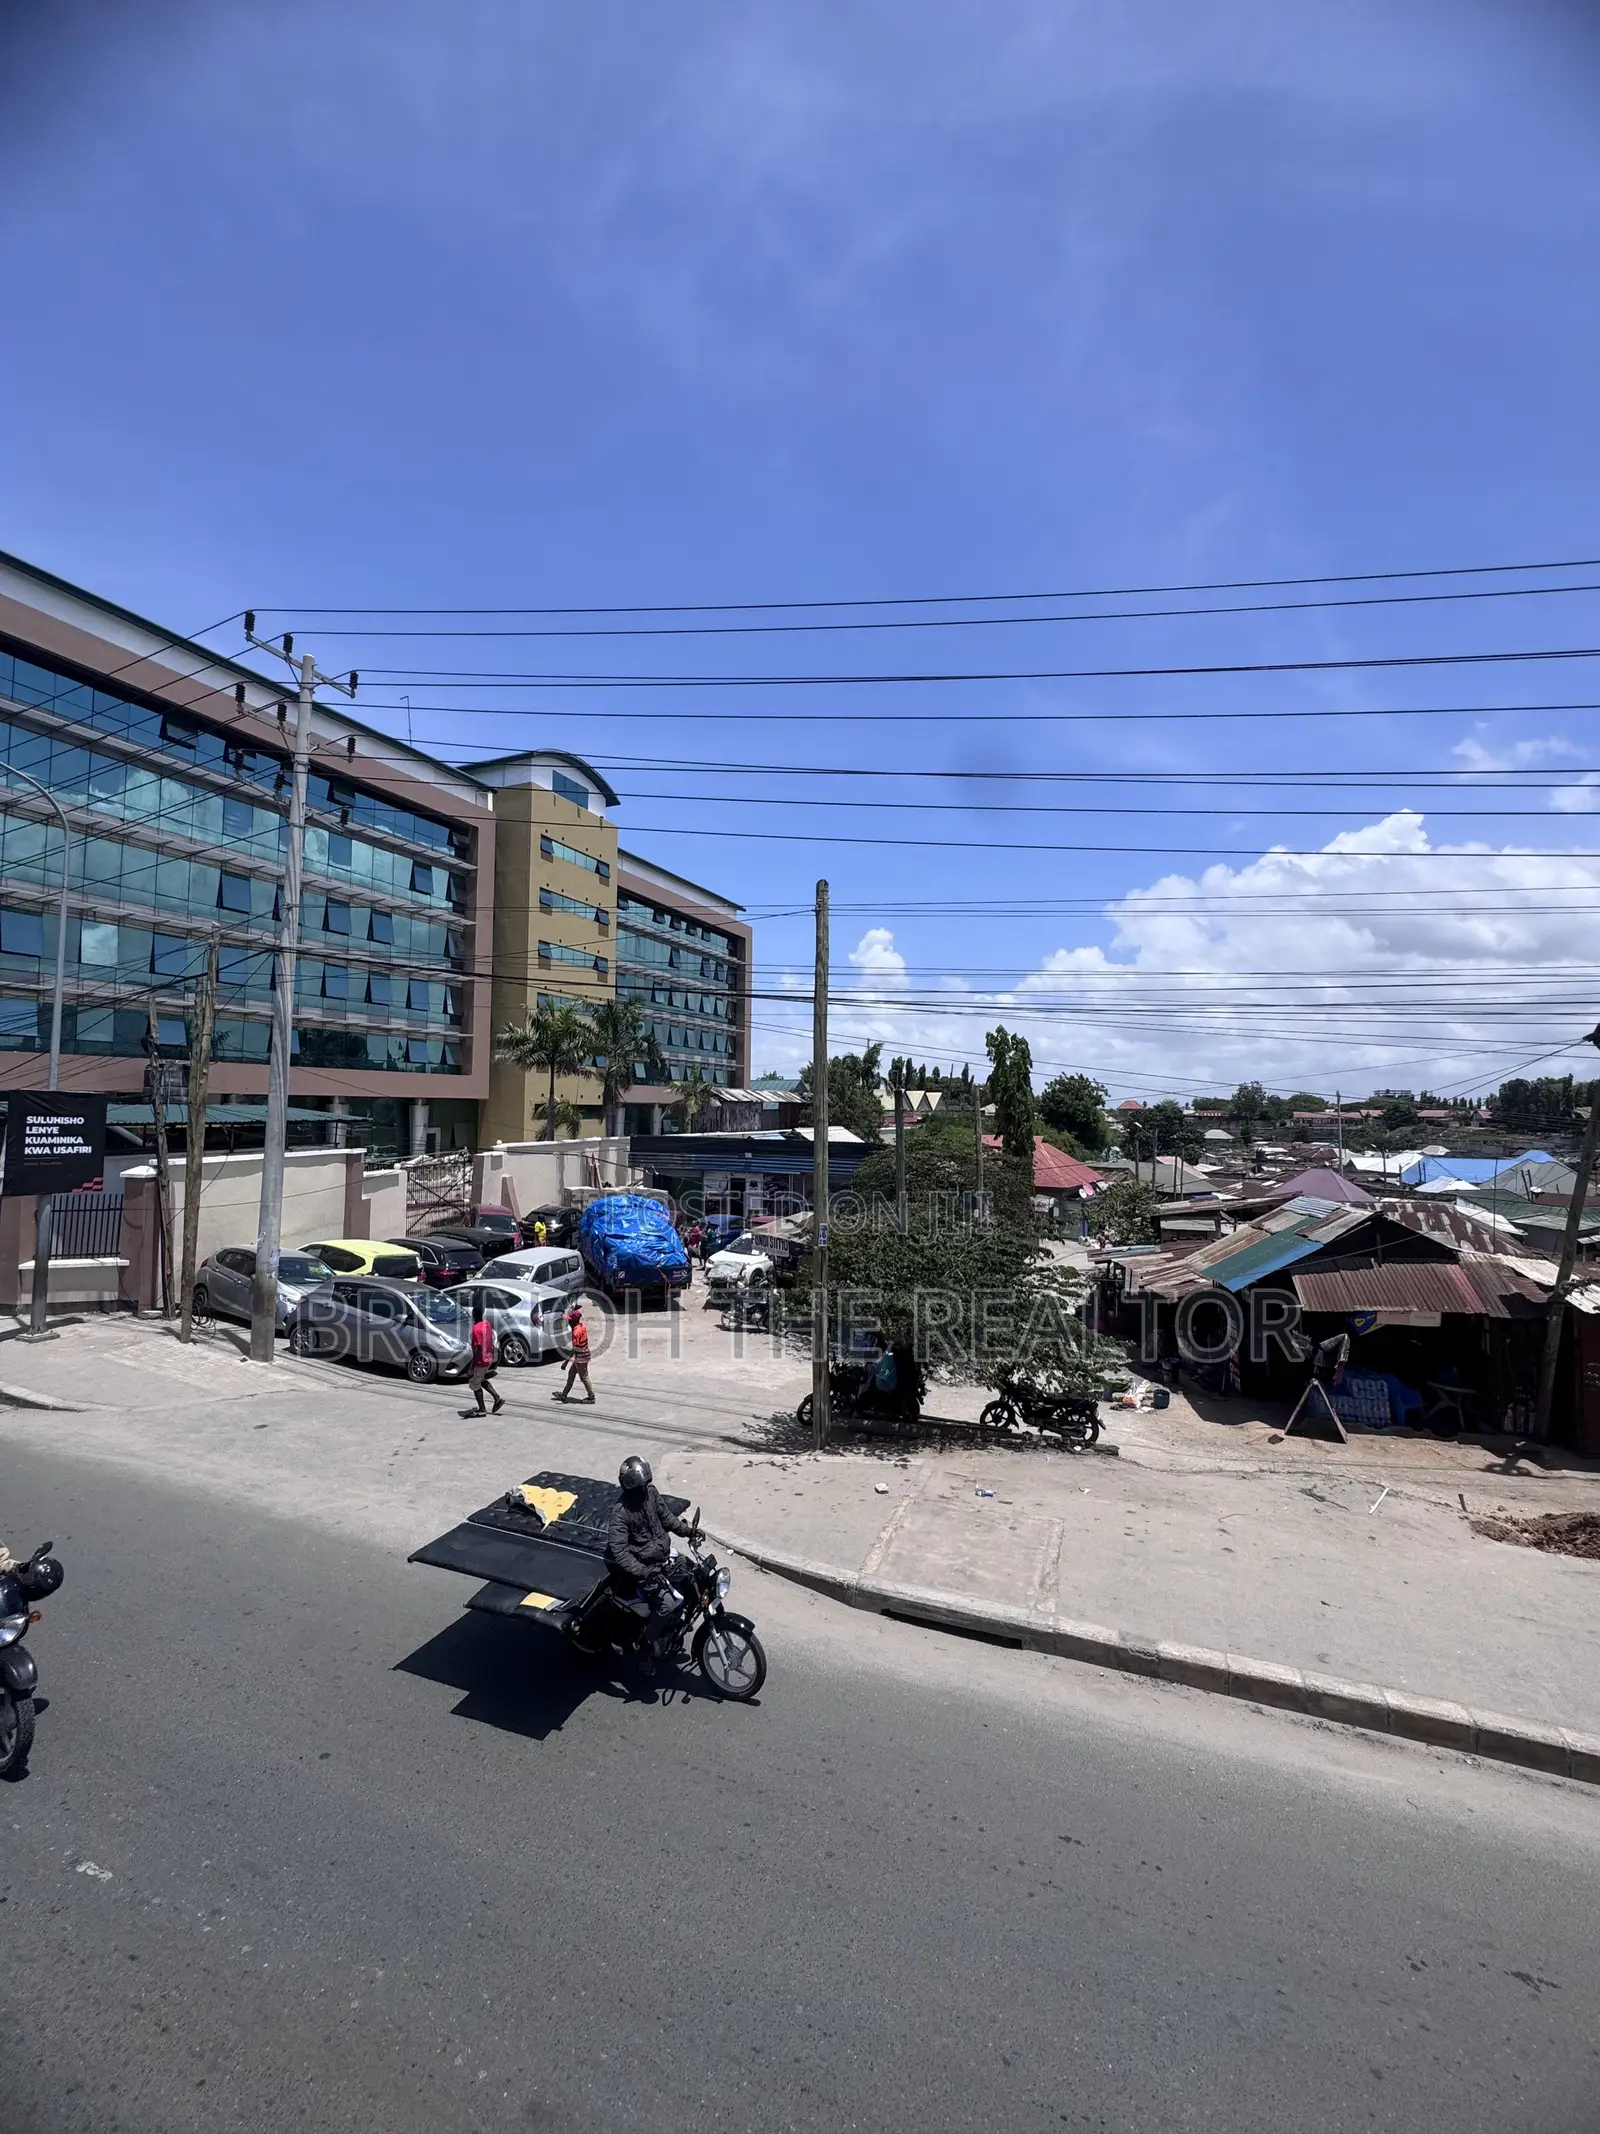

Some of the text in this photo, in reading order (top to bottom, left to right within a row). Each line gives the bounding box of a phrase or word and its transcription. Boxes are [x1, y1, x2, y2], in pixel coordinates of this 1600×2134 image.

[26, 1115, 85, 1125] SULUHISHO
[25, 1126, 60, 1134] LENYE
[25, 1136, 84, 1144] KUAMINIKA
[24, 1145, 92, 1155] KWA USAFIRI
